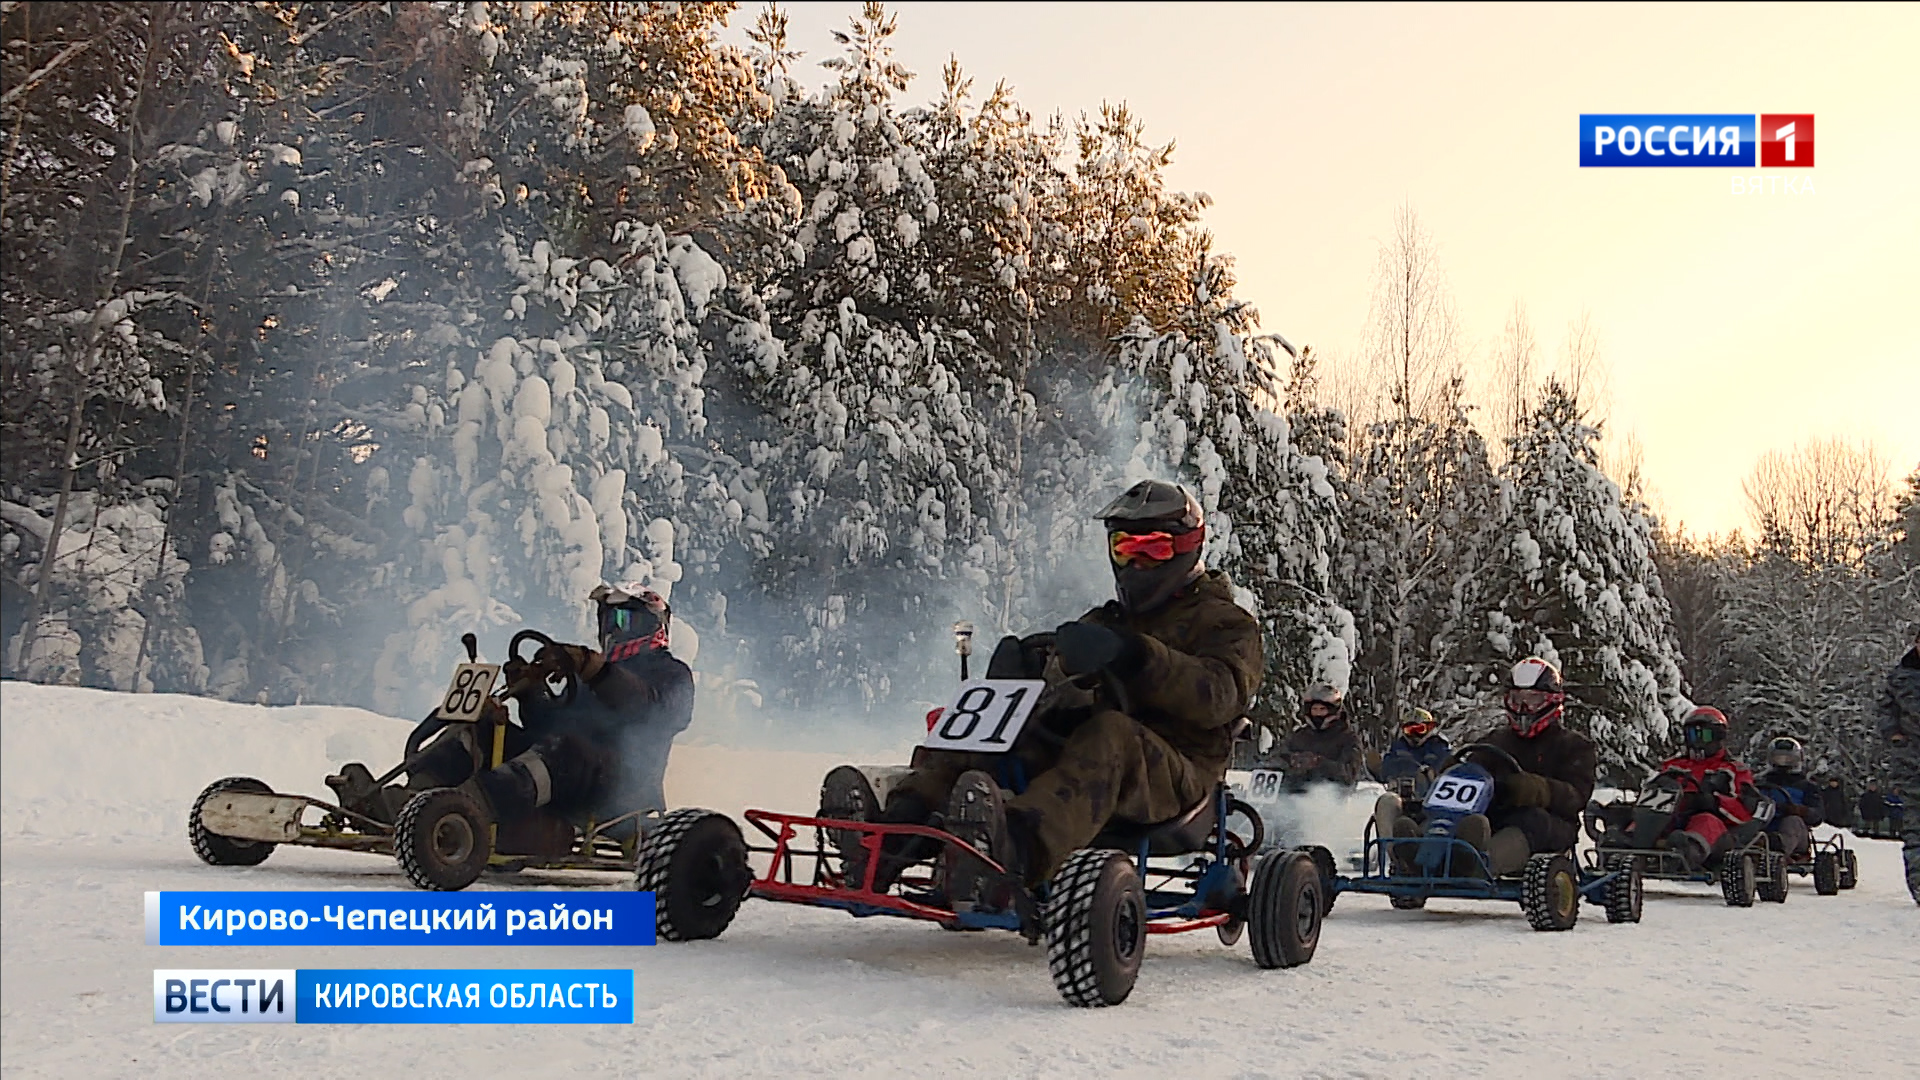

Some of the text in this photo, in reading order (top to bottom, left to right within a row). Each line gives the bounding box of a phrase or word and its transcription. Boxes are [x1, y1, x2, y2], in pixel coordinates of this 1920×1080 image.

[445, 669, 490, 714] 86
[939, 687, 1028, 744] 81
[1251, 773, 1278, 798] 88
[1435, 781, 1478, 804] 50
